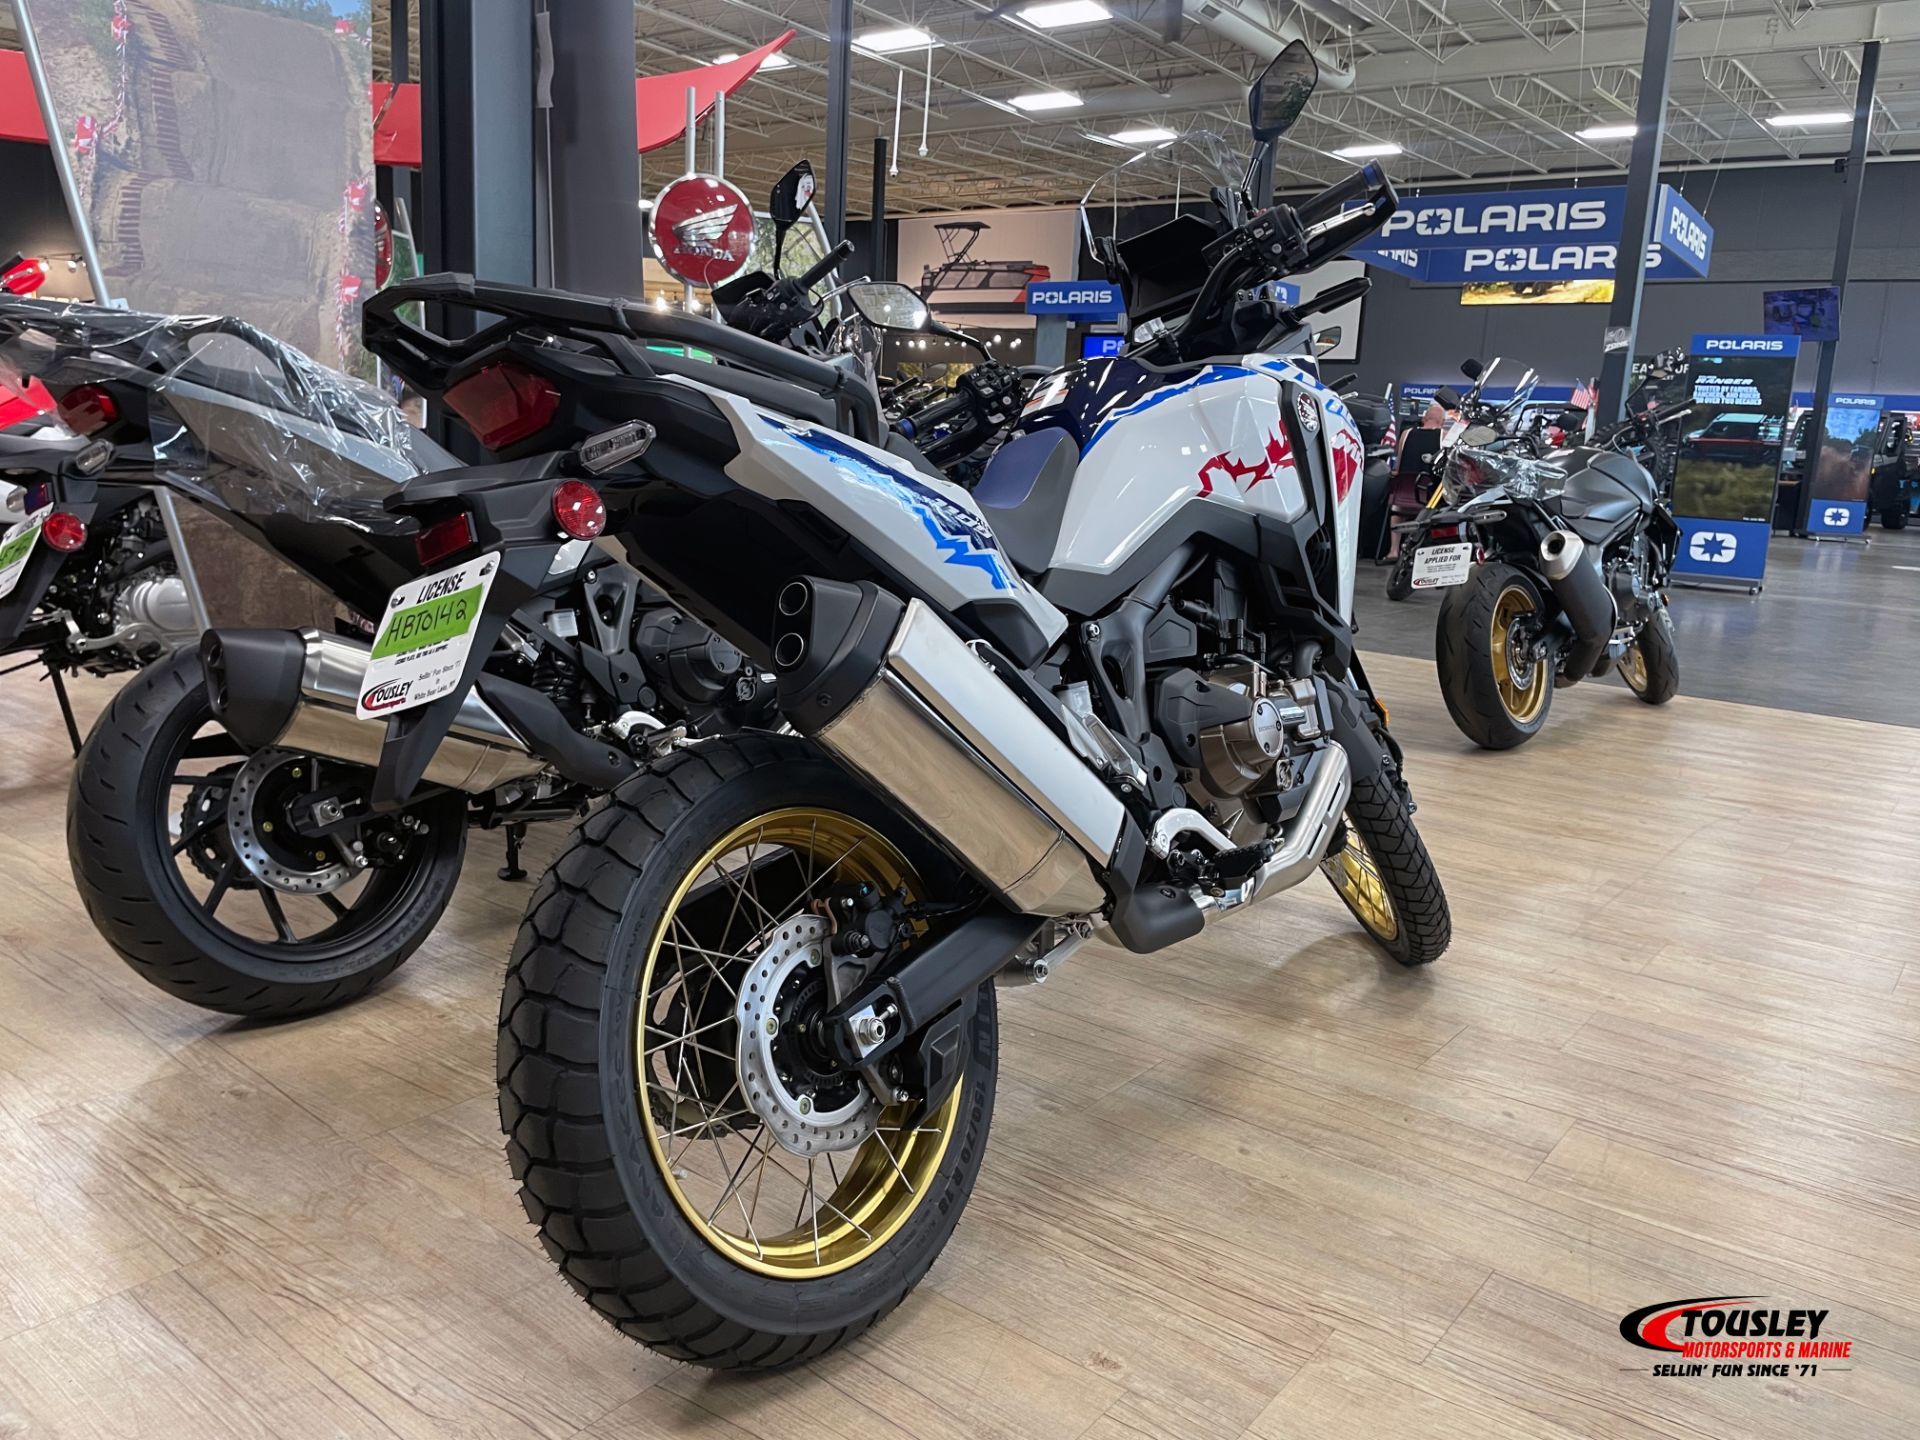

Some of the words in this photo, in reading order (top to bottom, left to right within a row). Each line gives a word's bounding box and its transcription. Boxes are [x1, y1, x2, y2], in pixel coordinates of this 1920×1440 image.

[1381, 200, 1606, 238] POLARIS
[1669, 206, 1708, 261] POLARIS
[1464, 244, 1662, 273] POLARS
[1032, 290, 1112, 304] POLARIS
[1706, 339, 1784, 351] POLARIS
[1695, 375, 1754, 385] RANGER
[1404, 387, 1438, 395] POLAR
[1835, 397, 1877, 406] POLARIS
[1431, 546, 1455, 555] LICENSE
[1424, 556, 1448, 564] APPLIED
[1449, 554, 1461, 562] FOR
[416, 571, 467, 604] LICENSE
